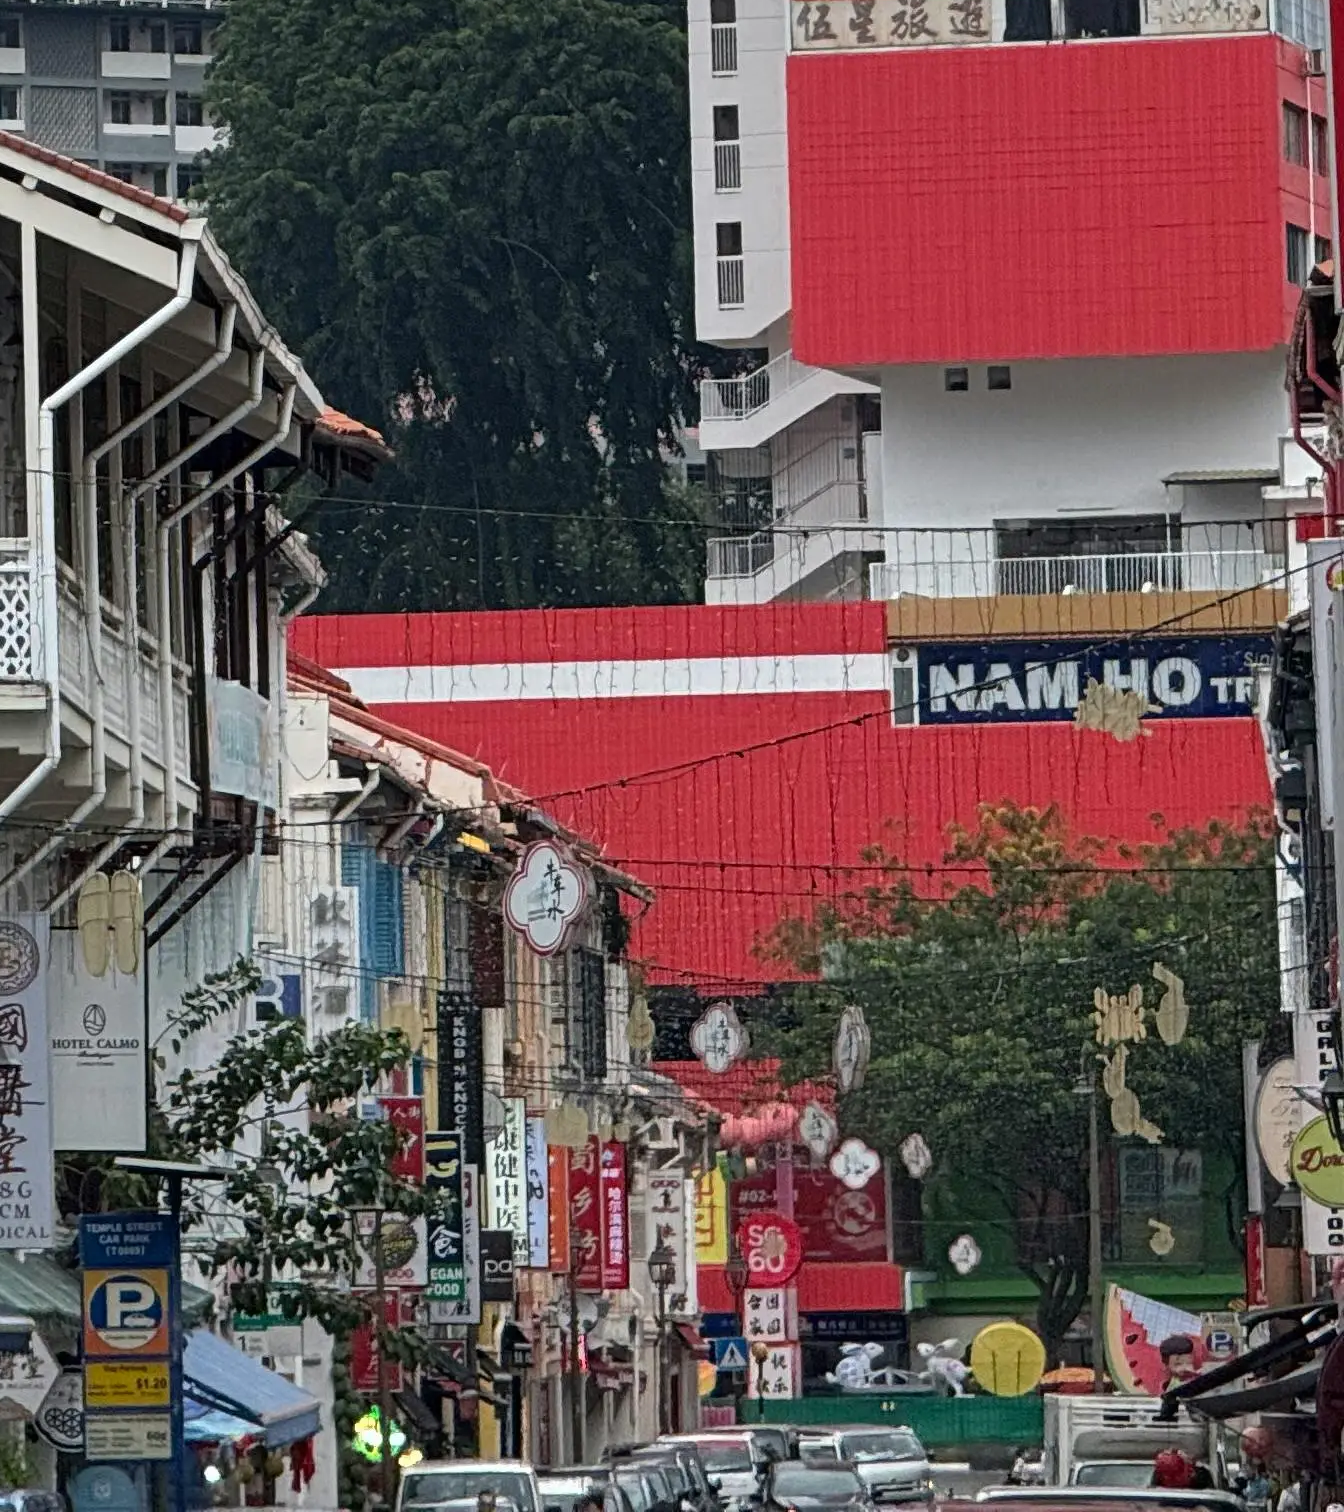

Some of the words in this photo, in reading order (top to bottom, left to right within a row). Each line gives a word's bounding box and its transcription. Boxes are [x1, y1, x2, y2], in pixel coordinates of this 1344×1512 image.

[929, 662, 1080, 712] NAM
[1103, 656, 1201, 707] HO
[52, 1039, 95, 1049] HOTEL
[97, 1038, 139, 1049] CALMO
[86, 1223, 123, 1233] TEMPLE
[125, 1222, 163, 1232] STREET
[430, 1267, 463, 1280] EGAN
[105, 1282, 155, 1328] P
